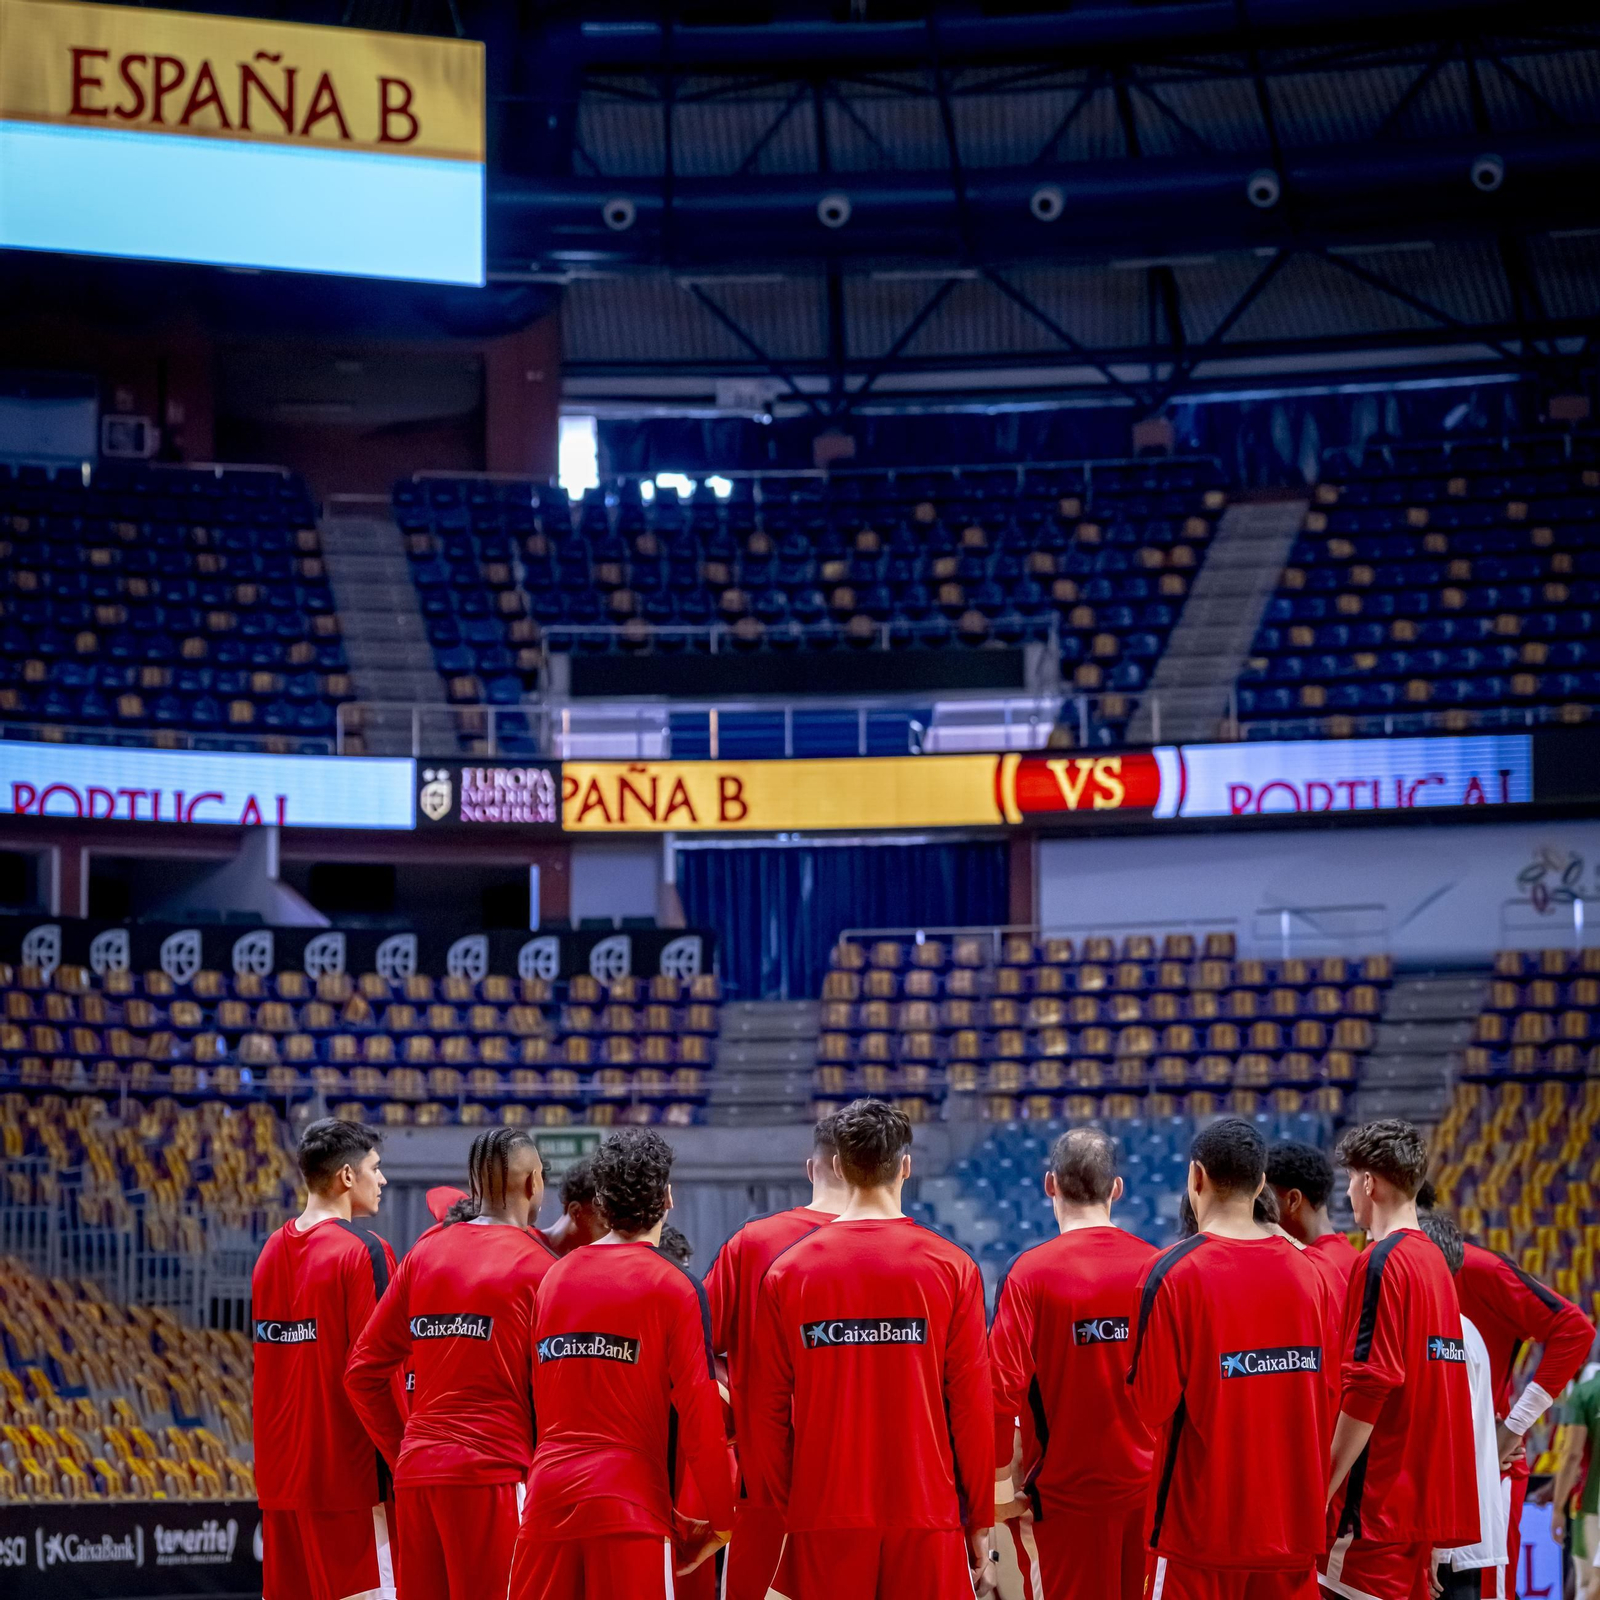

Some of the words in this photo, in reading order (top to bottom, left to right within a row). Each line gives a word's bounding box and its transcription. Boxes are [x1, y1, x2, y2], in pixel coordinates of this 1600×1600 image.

[68, 47, 352, 140] ESPAÑA
[377, 75, 420, 144] B
[1046, 756, 1125, 810] VS
[718, 775, 748, 822] B
[417, 1317, 487, 1338] CaixaBank
[828, 1321, 922, 1342] CaixaBank
[550, 1336, 634, 1362] CaixaBank
[1244, 1350, 1318, 1373] CaixaBank
